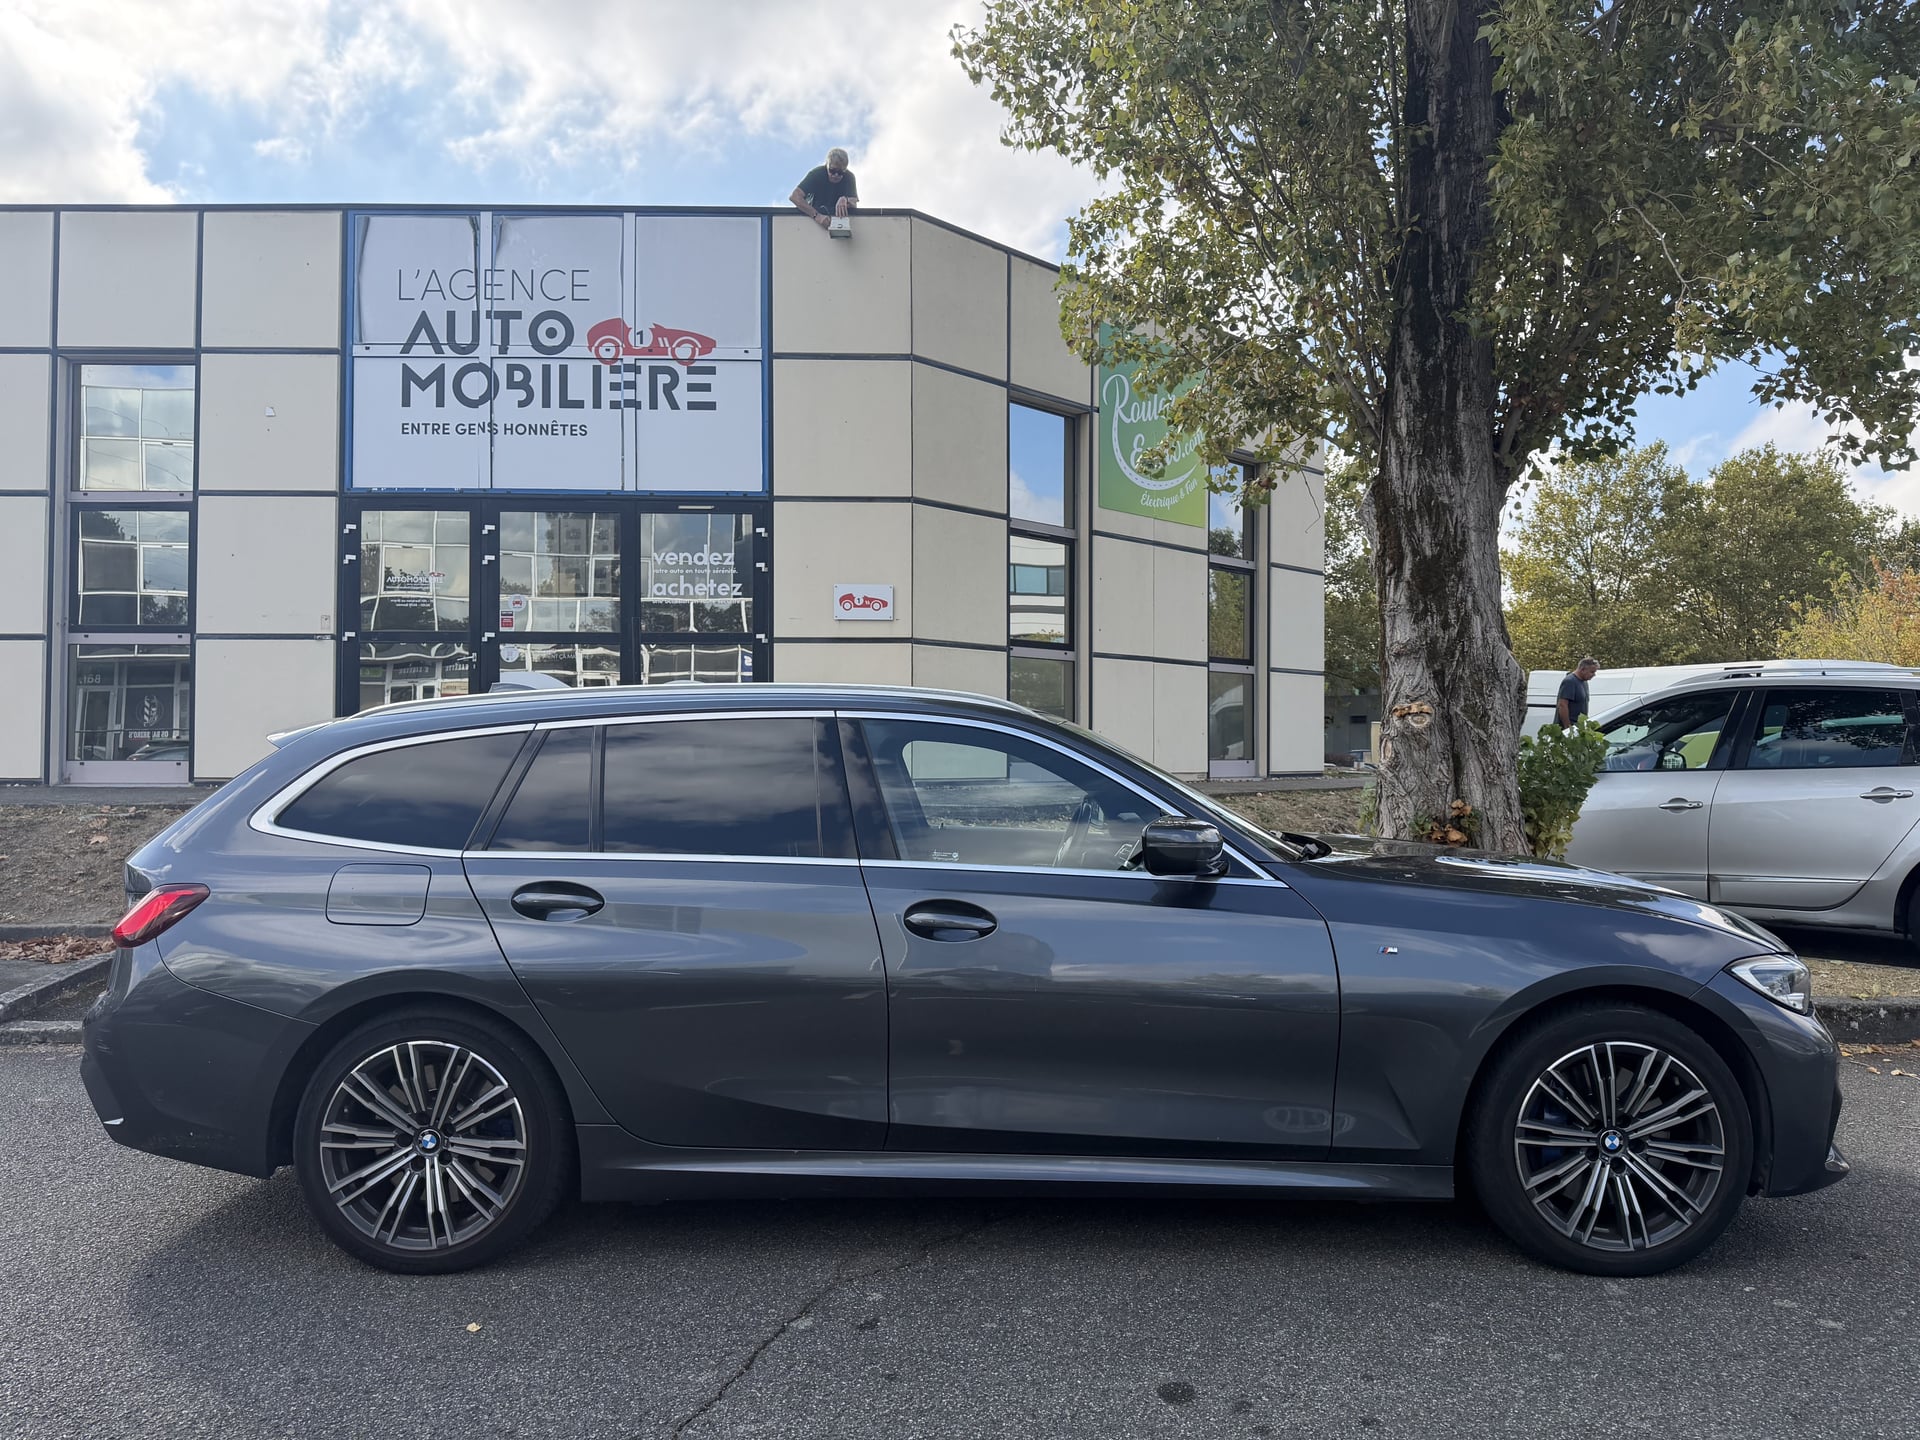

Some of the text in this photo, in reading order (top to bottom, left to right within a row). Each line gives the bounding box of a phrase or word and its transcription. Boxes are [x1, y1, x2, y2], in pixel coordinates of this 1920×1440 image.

[397, 269, 590, 301] L'AGENCE
[400, 310, 575, 355] AUTO
[636, 330, 644, 345] 1
[401, 362, 717, 410] MOBILIERE
[401, 420, 588, 436] ENTRE GENS HONNÊTES
[652, 543, 735, 566] vendez
[651, 566, 669, 574] otre
[652, 575, 743, 596] achetez
